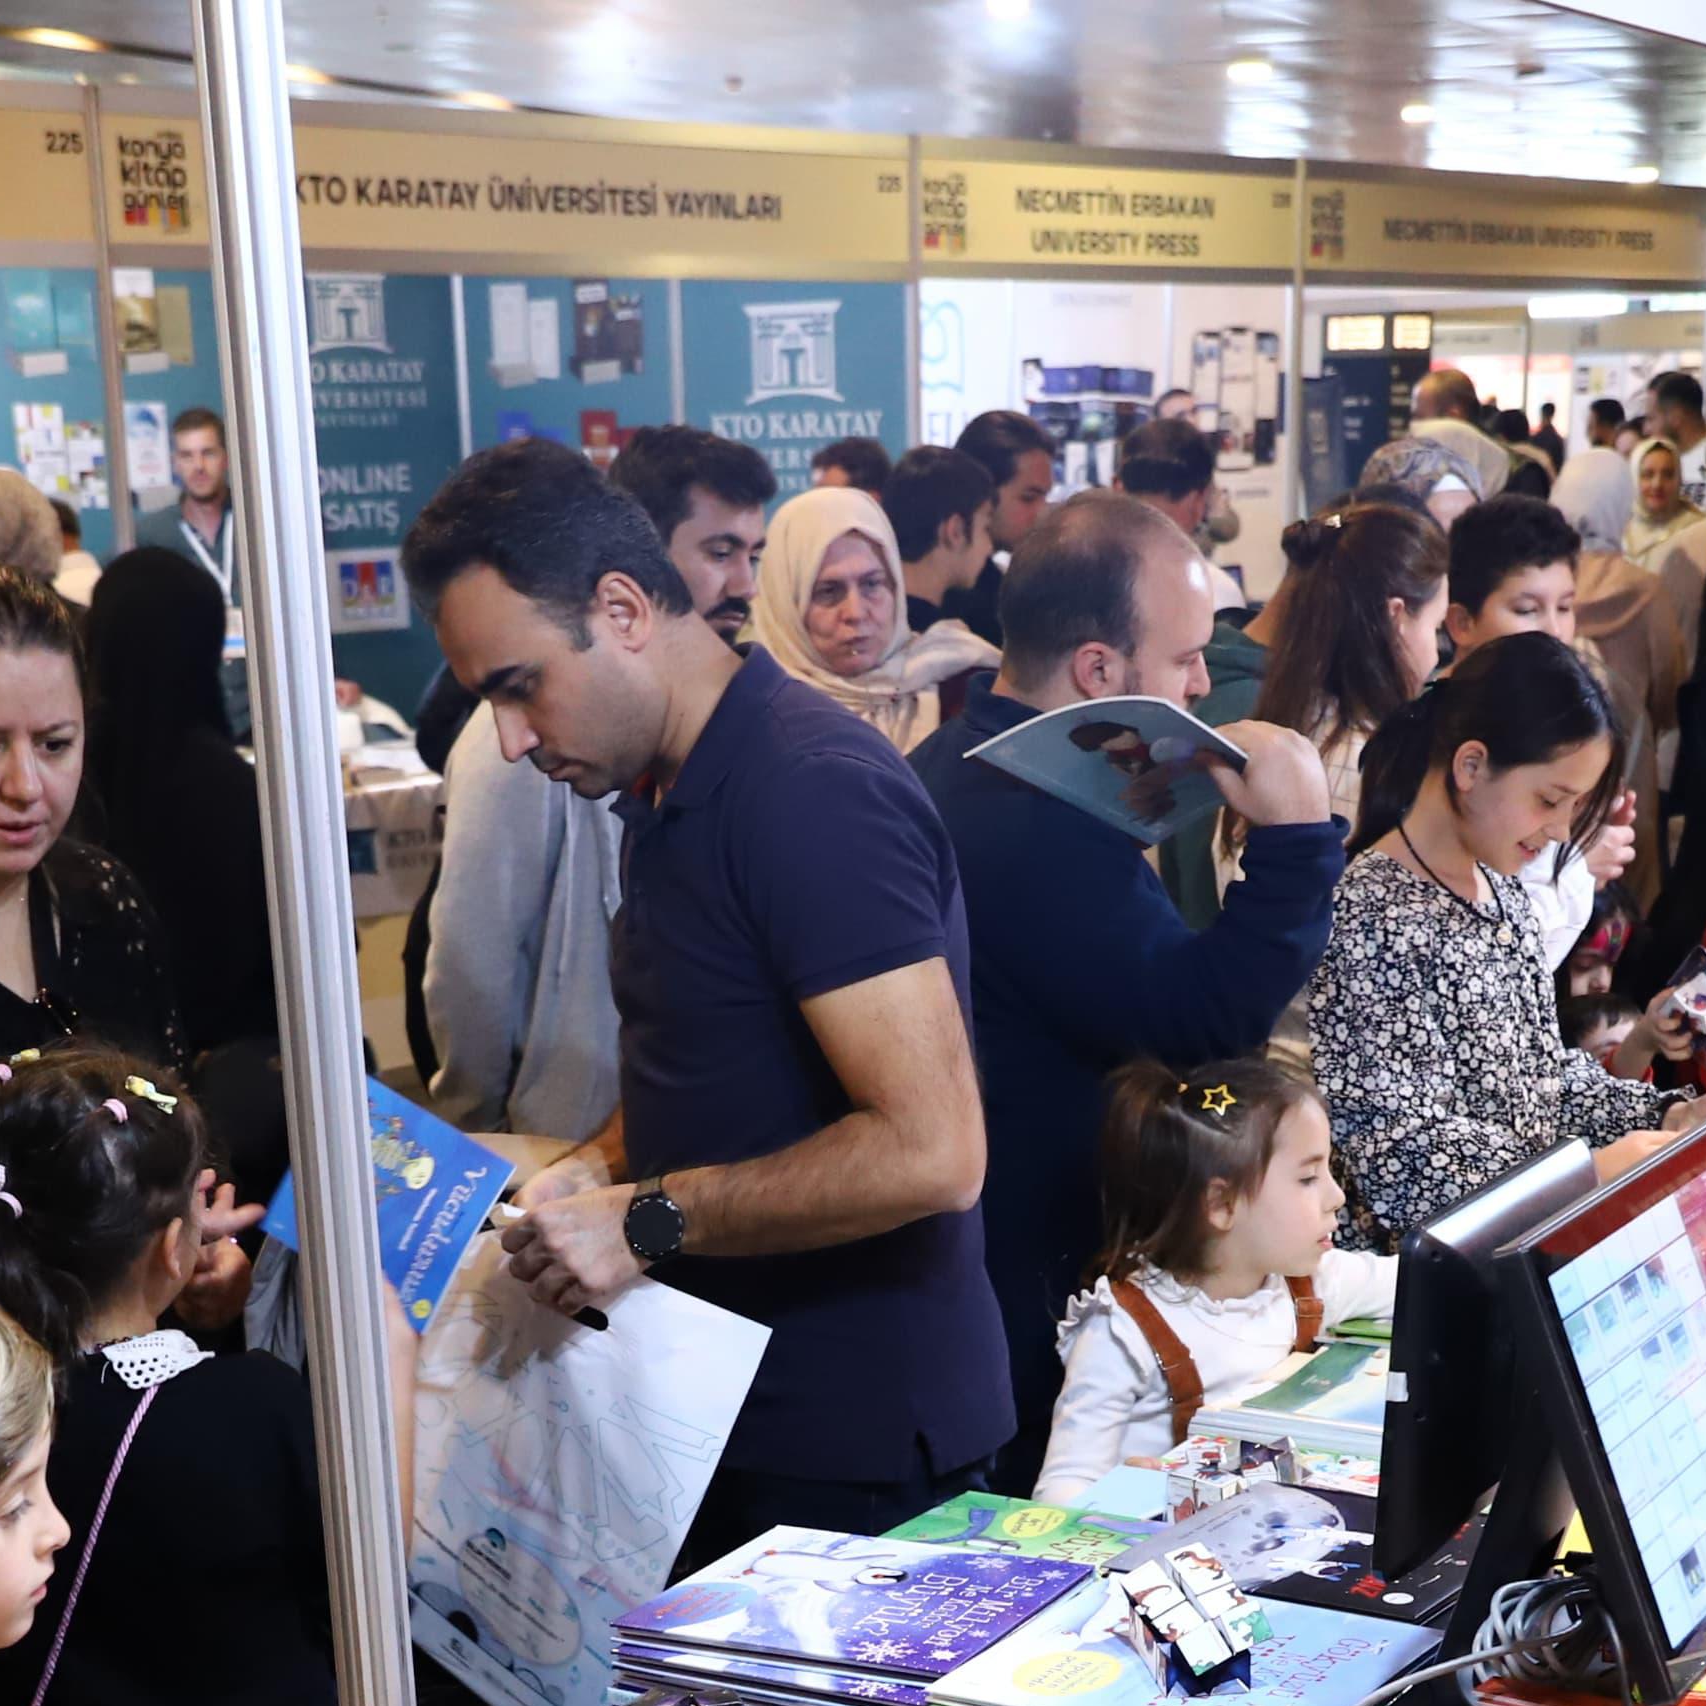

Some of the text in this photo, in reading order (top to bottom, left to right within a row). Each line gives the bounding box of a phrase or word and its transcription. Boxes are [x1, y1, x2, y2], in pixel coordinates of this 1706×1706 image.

[44, 131, 84, 156] 225
[355, 177, 482, 212] KARATAY
[487, 176, 659, 219] ÜNİVERSİTESİ
[663, 190, 784, 223] YAYINLARI
[1014, 184, 1217, 220] NECMETTİN ERBAKAN
[1030, 229, 1201, 259] UNIVERSITY PRESS
[328, 360, 426, 384] KARATAY
[711, 410, 884, 440] KTO KARATAY
[323, 501, 402, 536] SATIŞ
